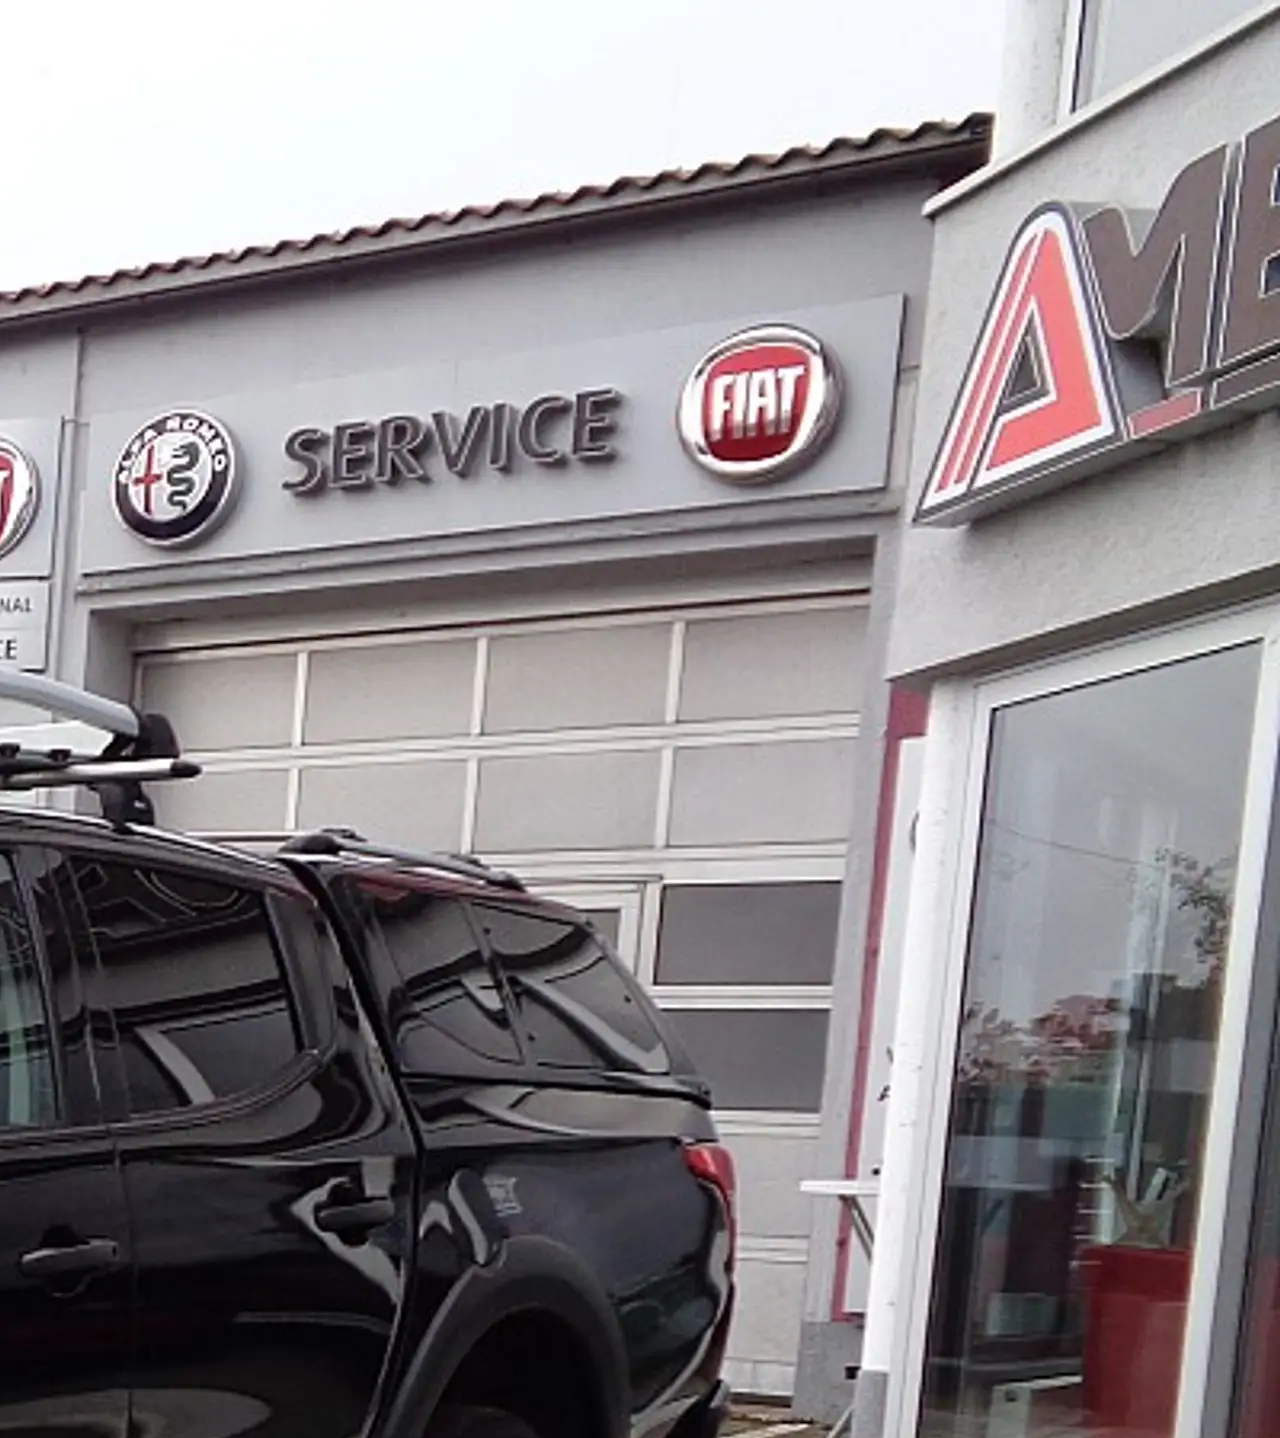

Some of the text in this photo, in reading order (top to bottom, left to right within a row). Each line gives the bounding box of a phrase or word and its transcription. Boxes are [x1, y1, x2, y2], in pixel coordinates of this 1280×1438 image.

[282, 386, 618, 496] SERVICE
[708, 364, 806, 442] FIAT
[165, 415, 228, 472] ROMEO
